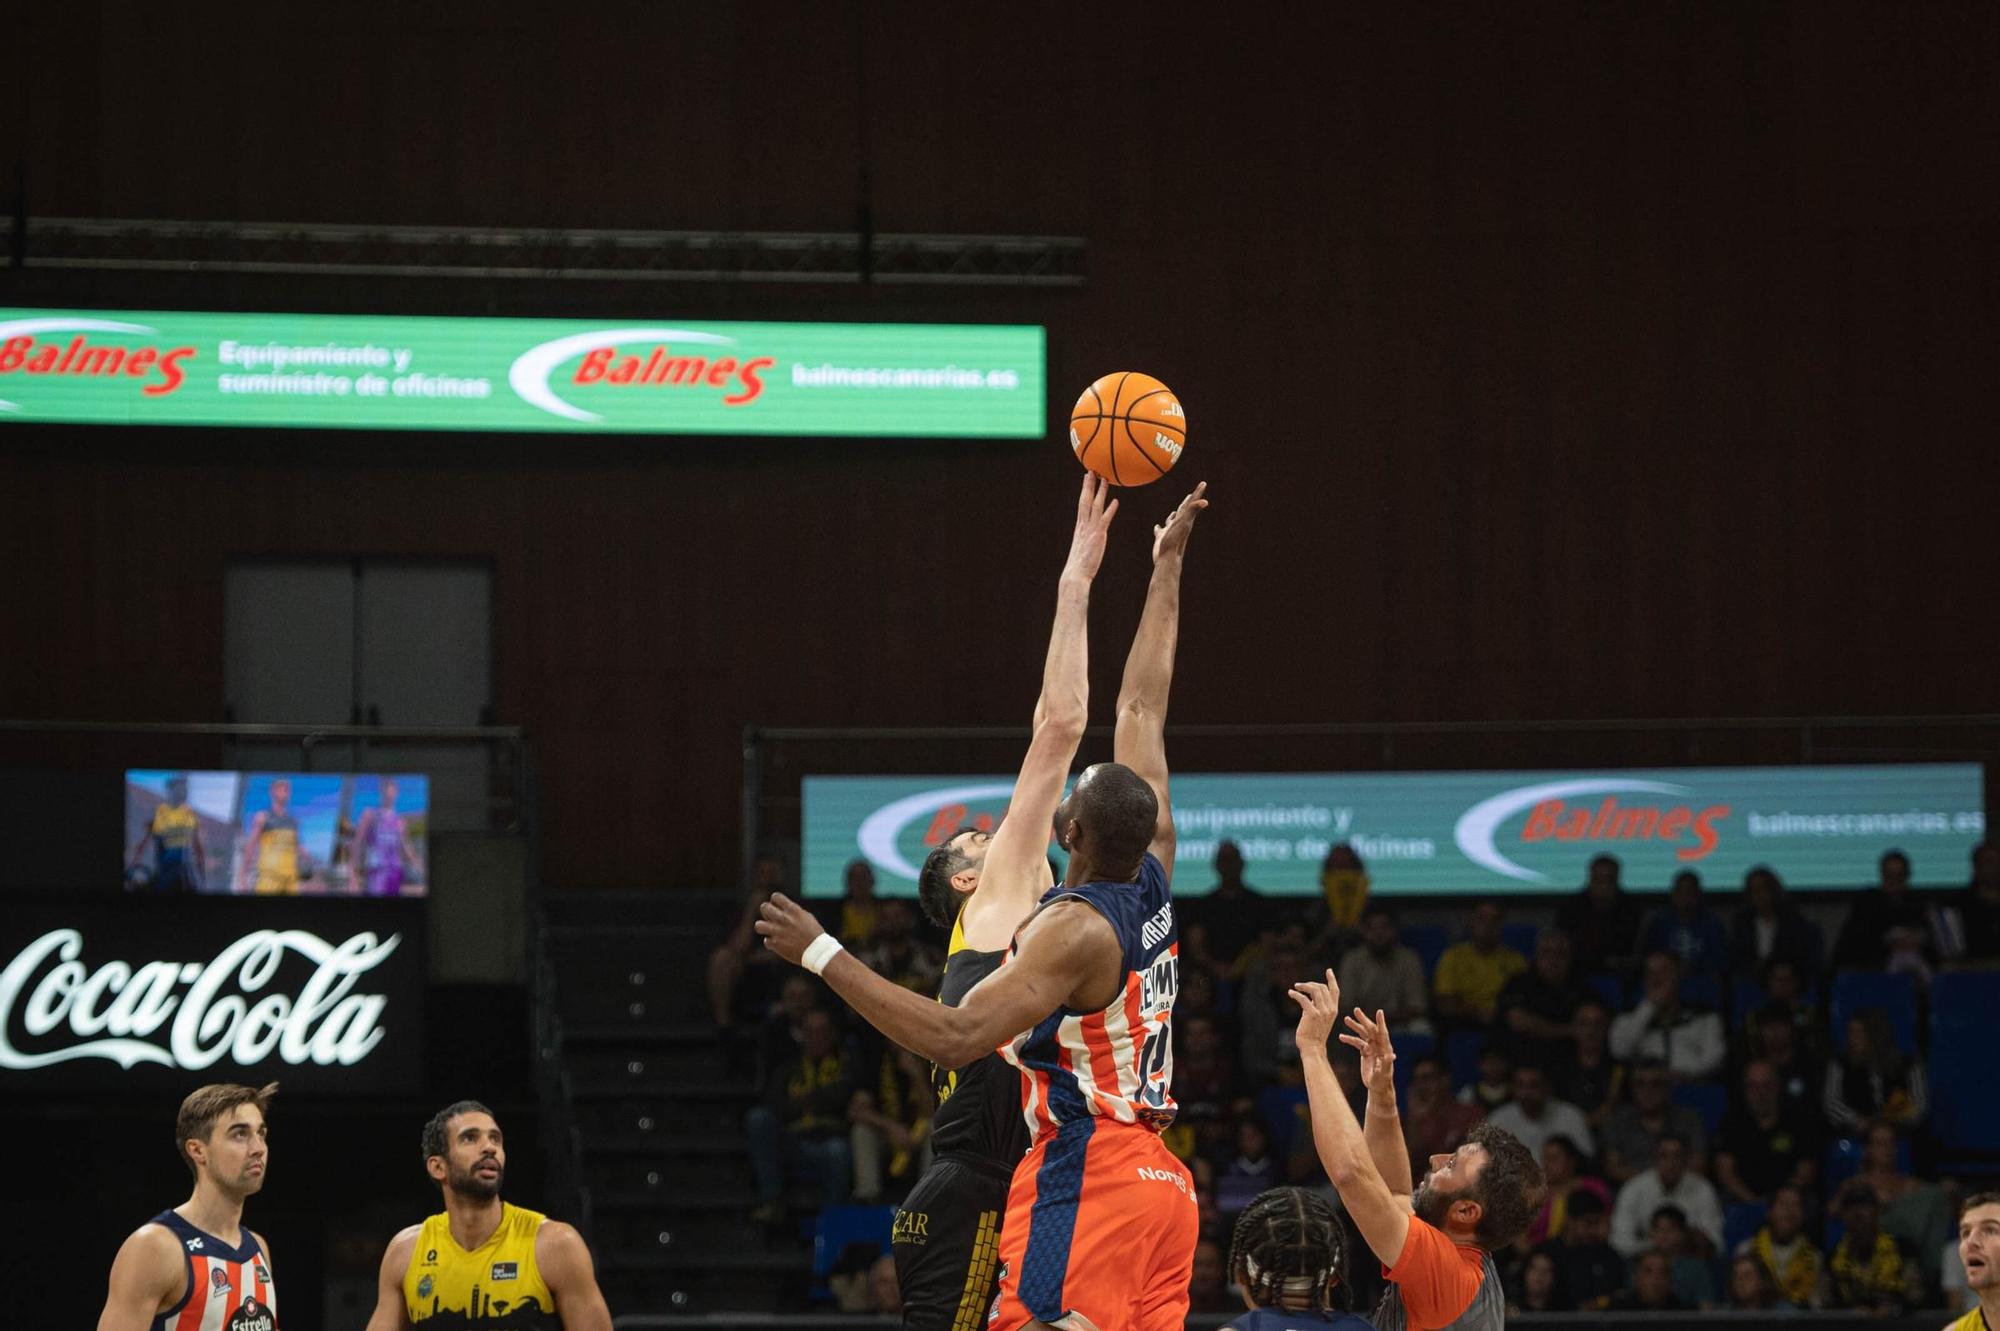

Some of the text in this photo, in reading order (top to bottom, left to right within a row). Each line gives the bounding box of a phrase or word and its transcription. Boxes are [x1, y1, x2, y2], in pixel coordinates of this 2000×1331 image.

[0, 336, 197, 397] Balmes
[218, 340, 412, 372] Equipamiento y
[218, 372, 492, 398] suministro de oficinas
[574, 347, 775, 406] Balmes
[790, 362, 1020, 390] balmescanarias.es
[1173, 803, 1354, 835] quipamiento y
[1523, 798, 1730, 861] Balmes
[1748, 808, 1986, 836] balmescanarias.es
[0, 928, 401, 1071] Coca-Cola
